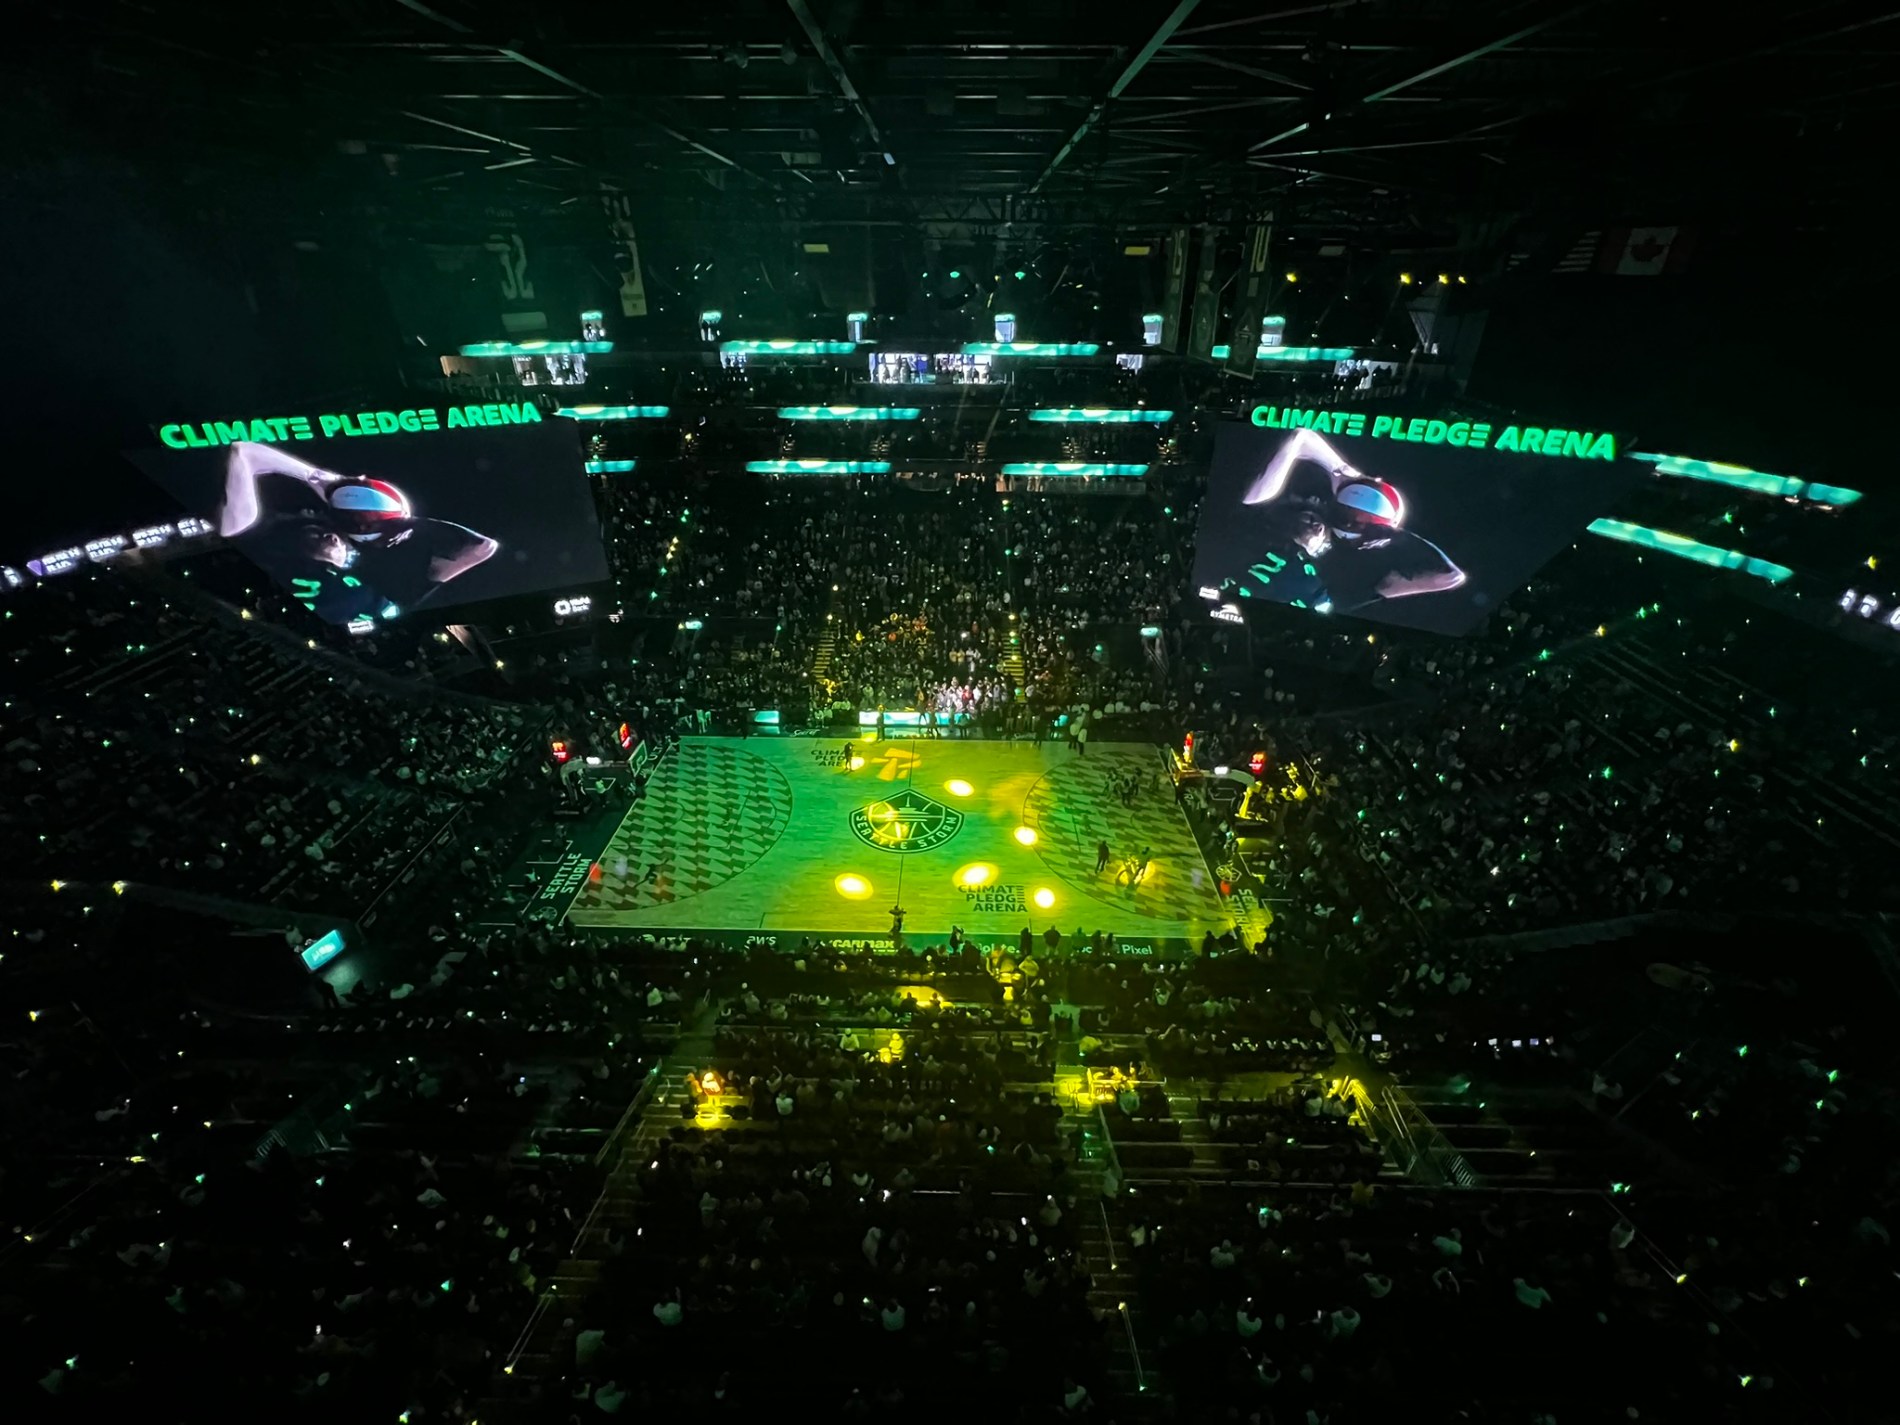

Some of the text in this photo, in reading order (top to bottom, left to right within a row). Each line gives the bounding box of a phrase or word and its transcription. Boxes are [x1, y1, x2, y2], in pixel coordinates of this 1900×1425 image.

[160, 401, 541, 449] CLIMATE PLEDGE ARENA
[1251, 406, 1616, 461] CLIMATE PLEDGE ARENA
[855, 814, 957, 850] SEATTLE STORM
[540, 852, 582, 899] SEATTLE
[560, 858, 593, 894] STORM
[958, 884, 1024, 894] CLIMATE
[966, 893, 1025, 903] PLEDGE
[973, 903, 1028, 912] ARENA
[1121, 944, 1153, 955] Pixel
